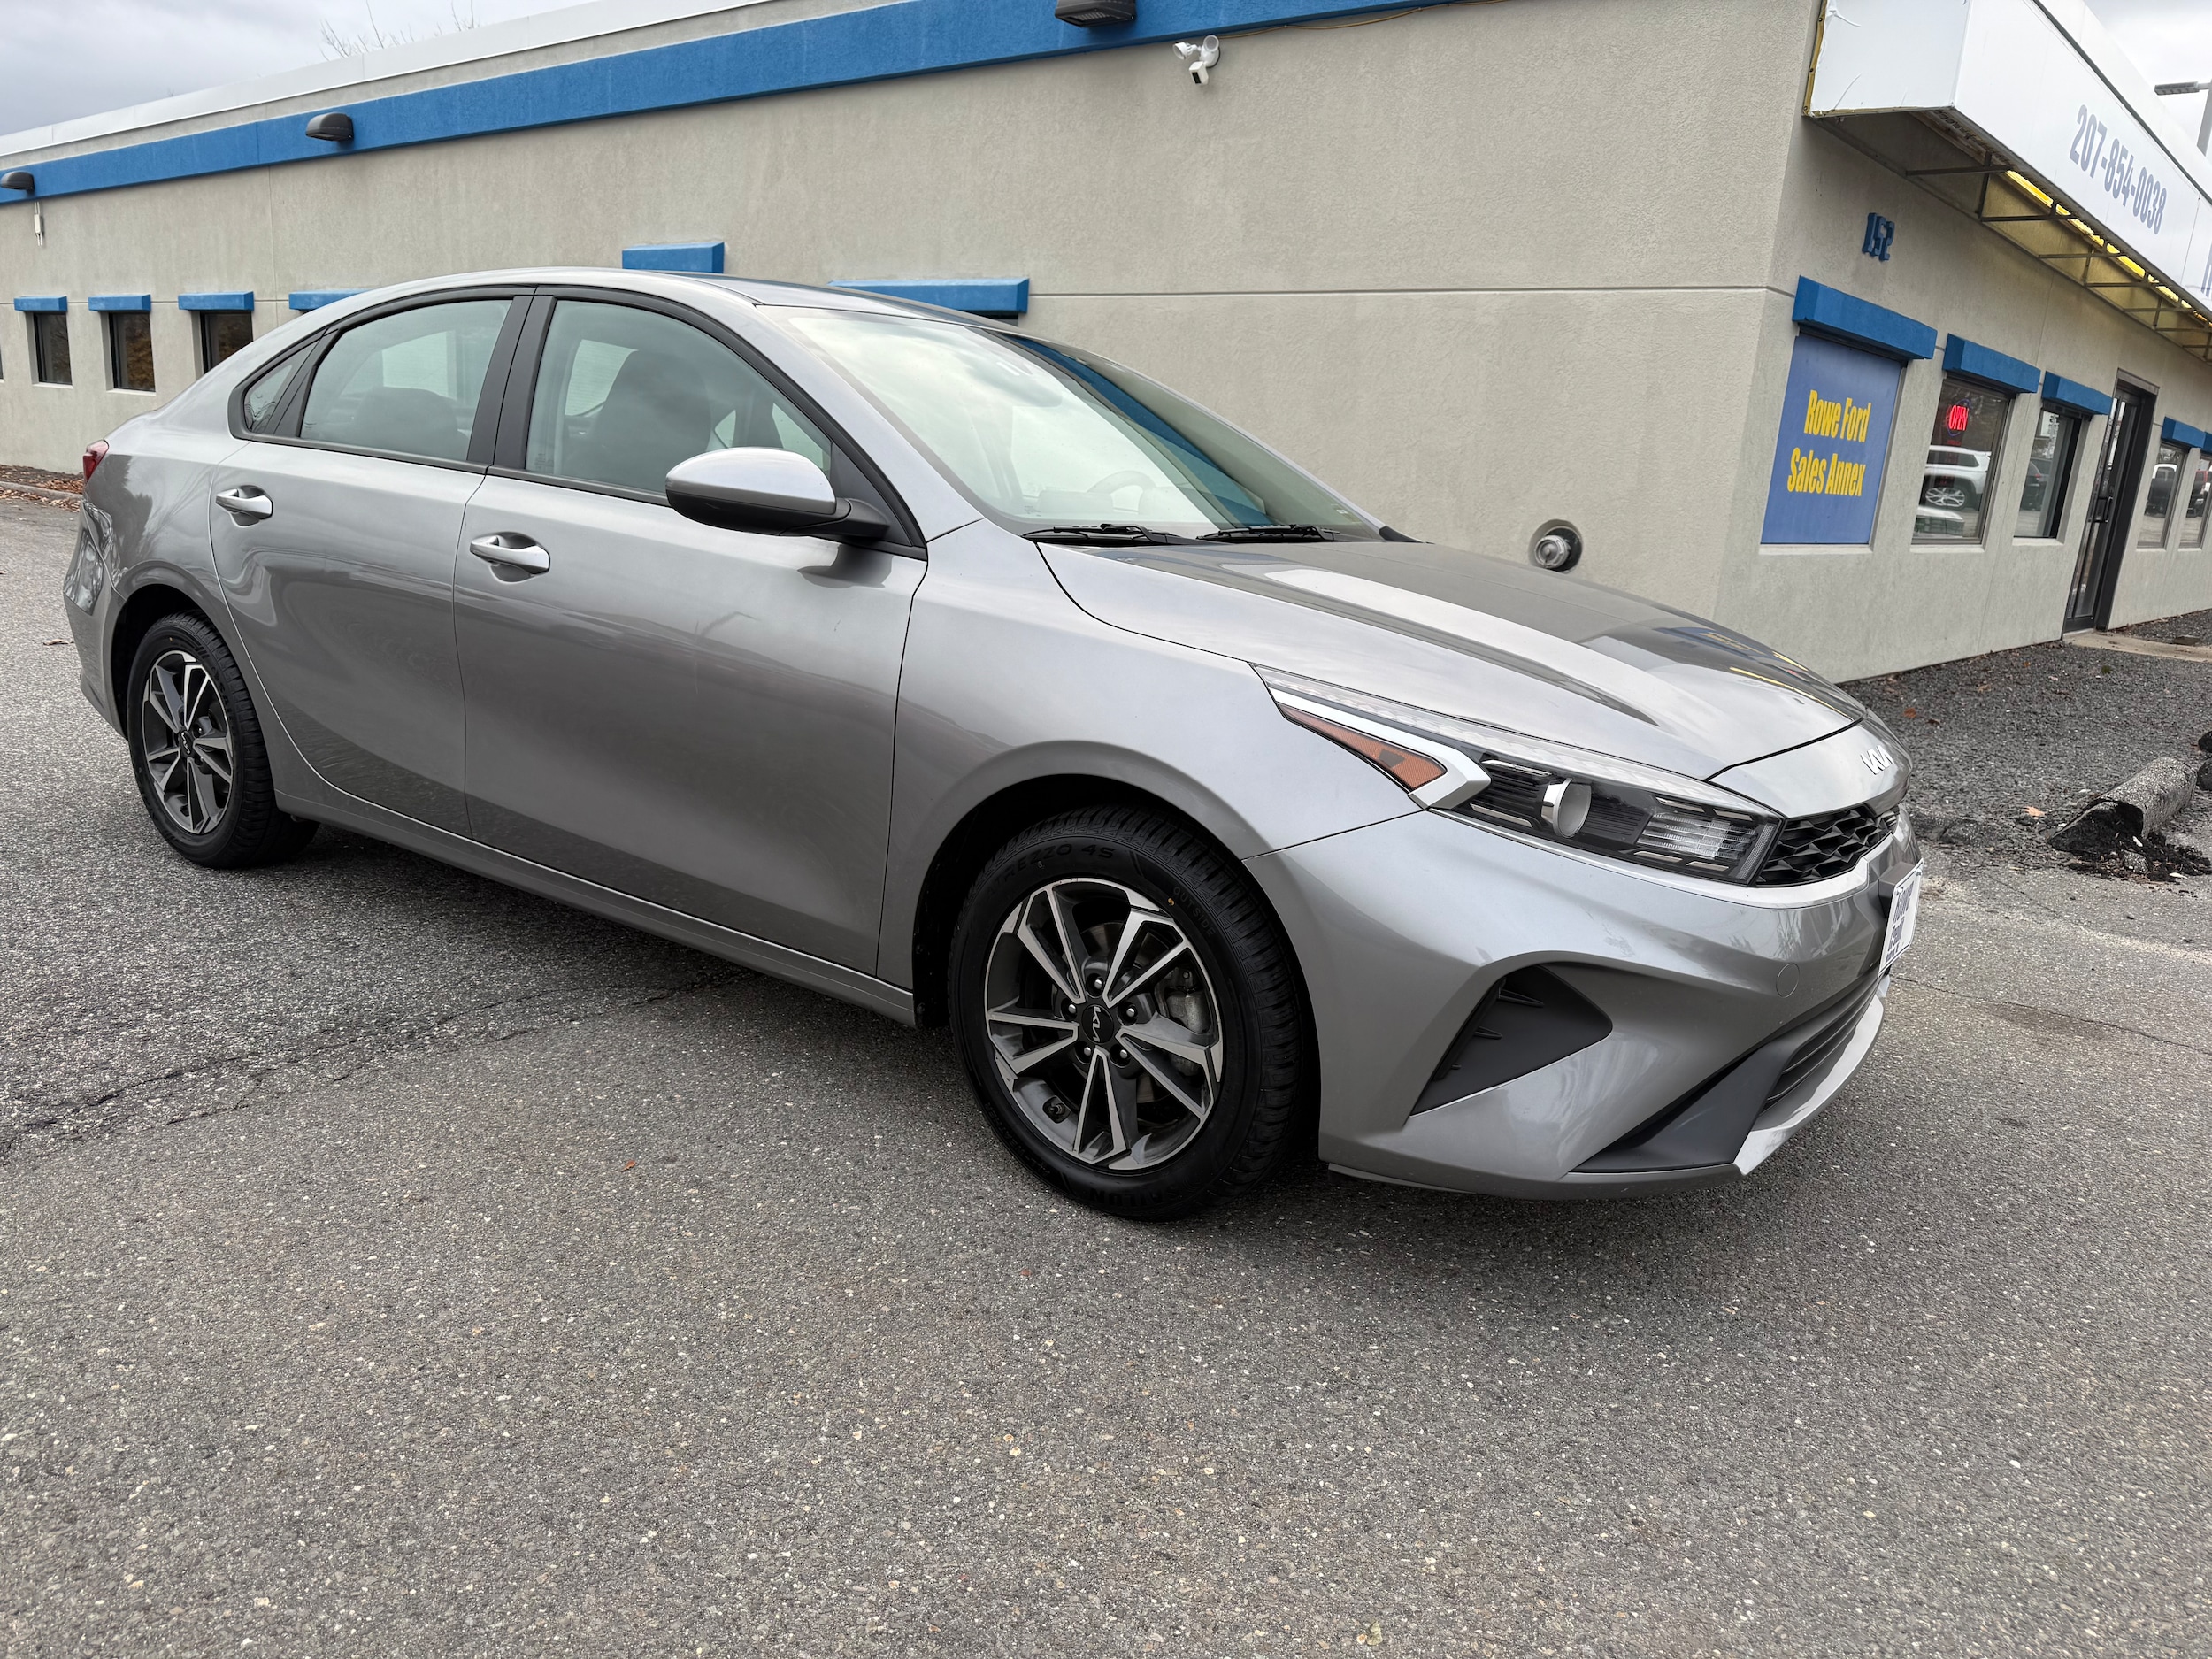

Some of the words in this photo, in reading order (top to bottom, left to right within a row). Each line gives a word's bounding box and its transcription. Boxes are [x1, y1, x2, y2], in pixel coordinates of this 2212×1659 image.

[2070, 104, 2168, 234] 207-854-0038
[1862, 212, 1895, 261] 152
[1804, 389, 1842, 438] Rowe
[1840, 397, 1871, 442] Ford
[1948, 405, 1970, 431] OPEN
[1787, 447, 1827, 494] Sales
[1824, 452, 1866, 496] Annex
[1081, 844, 1116, 859] 4S
[1173, 886, 1217, 938] OUTSIDE
